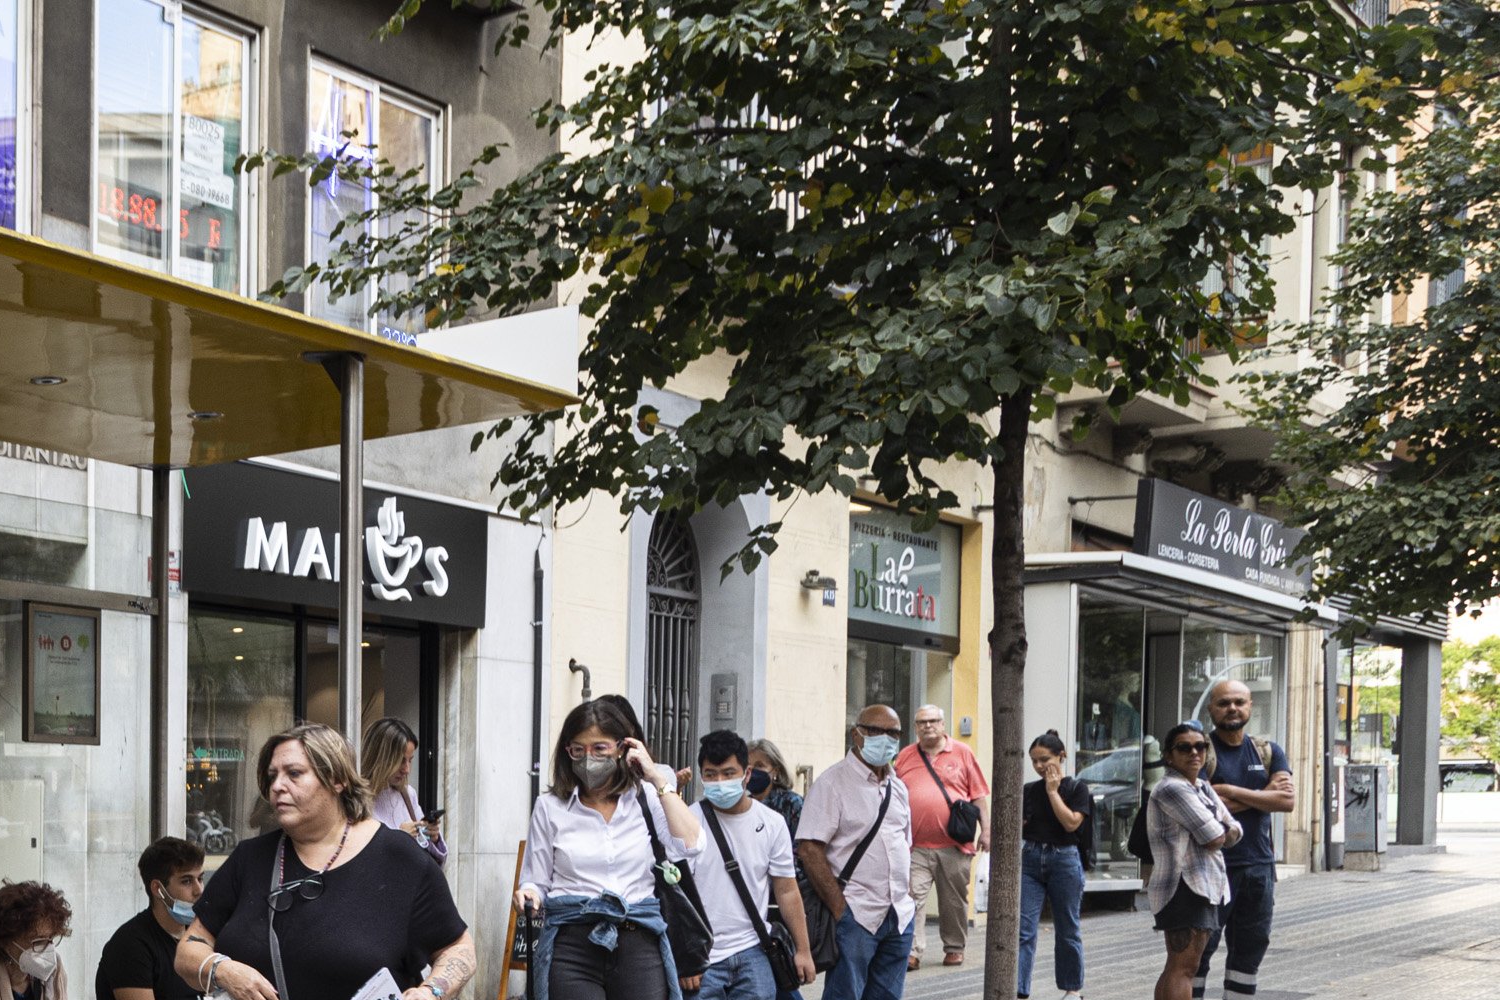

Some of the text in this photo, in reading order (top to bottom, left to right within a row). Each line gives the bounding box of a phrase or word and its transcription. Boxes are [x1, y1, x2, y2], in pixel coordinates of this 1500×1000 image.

[854, 521, 885, 537] PIZZERIA
[893, 531, 938, 551] RESTAURANTE
[1180, 498, 1209, 546] La
[1210, 508, 1259, 560] Perla
[871, 542, 897, 584] La
[1157, 543, 1183, 561] LENCERIA
[1187, 551, 1219, 571] CORSETERIA
[853, 567, 936, 621] Burrata
